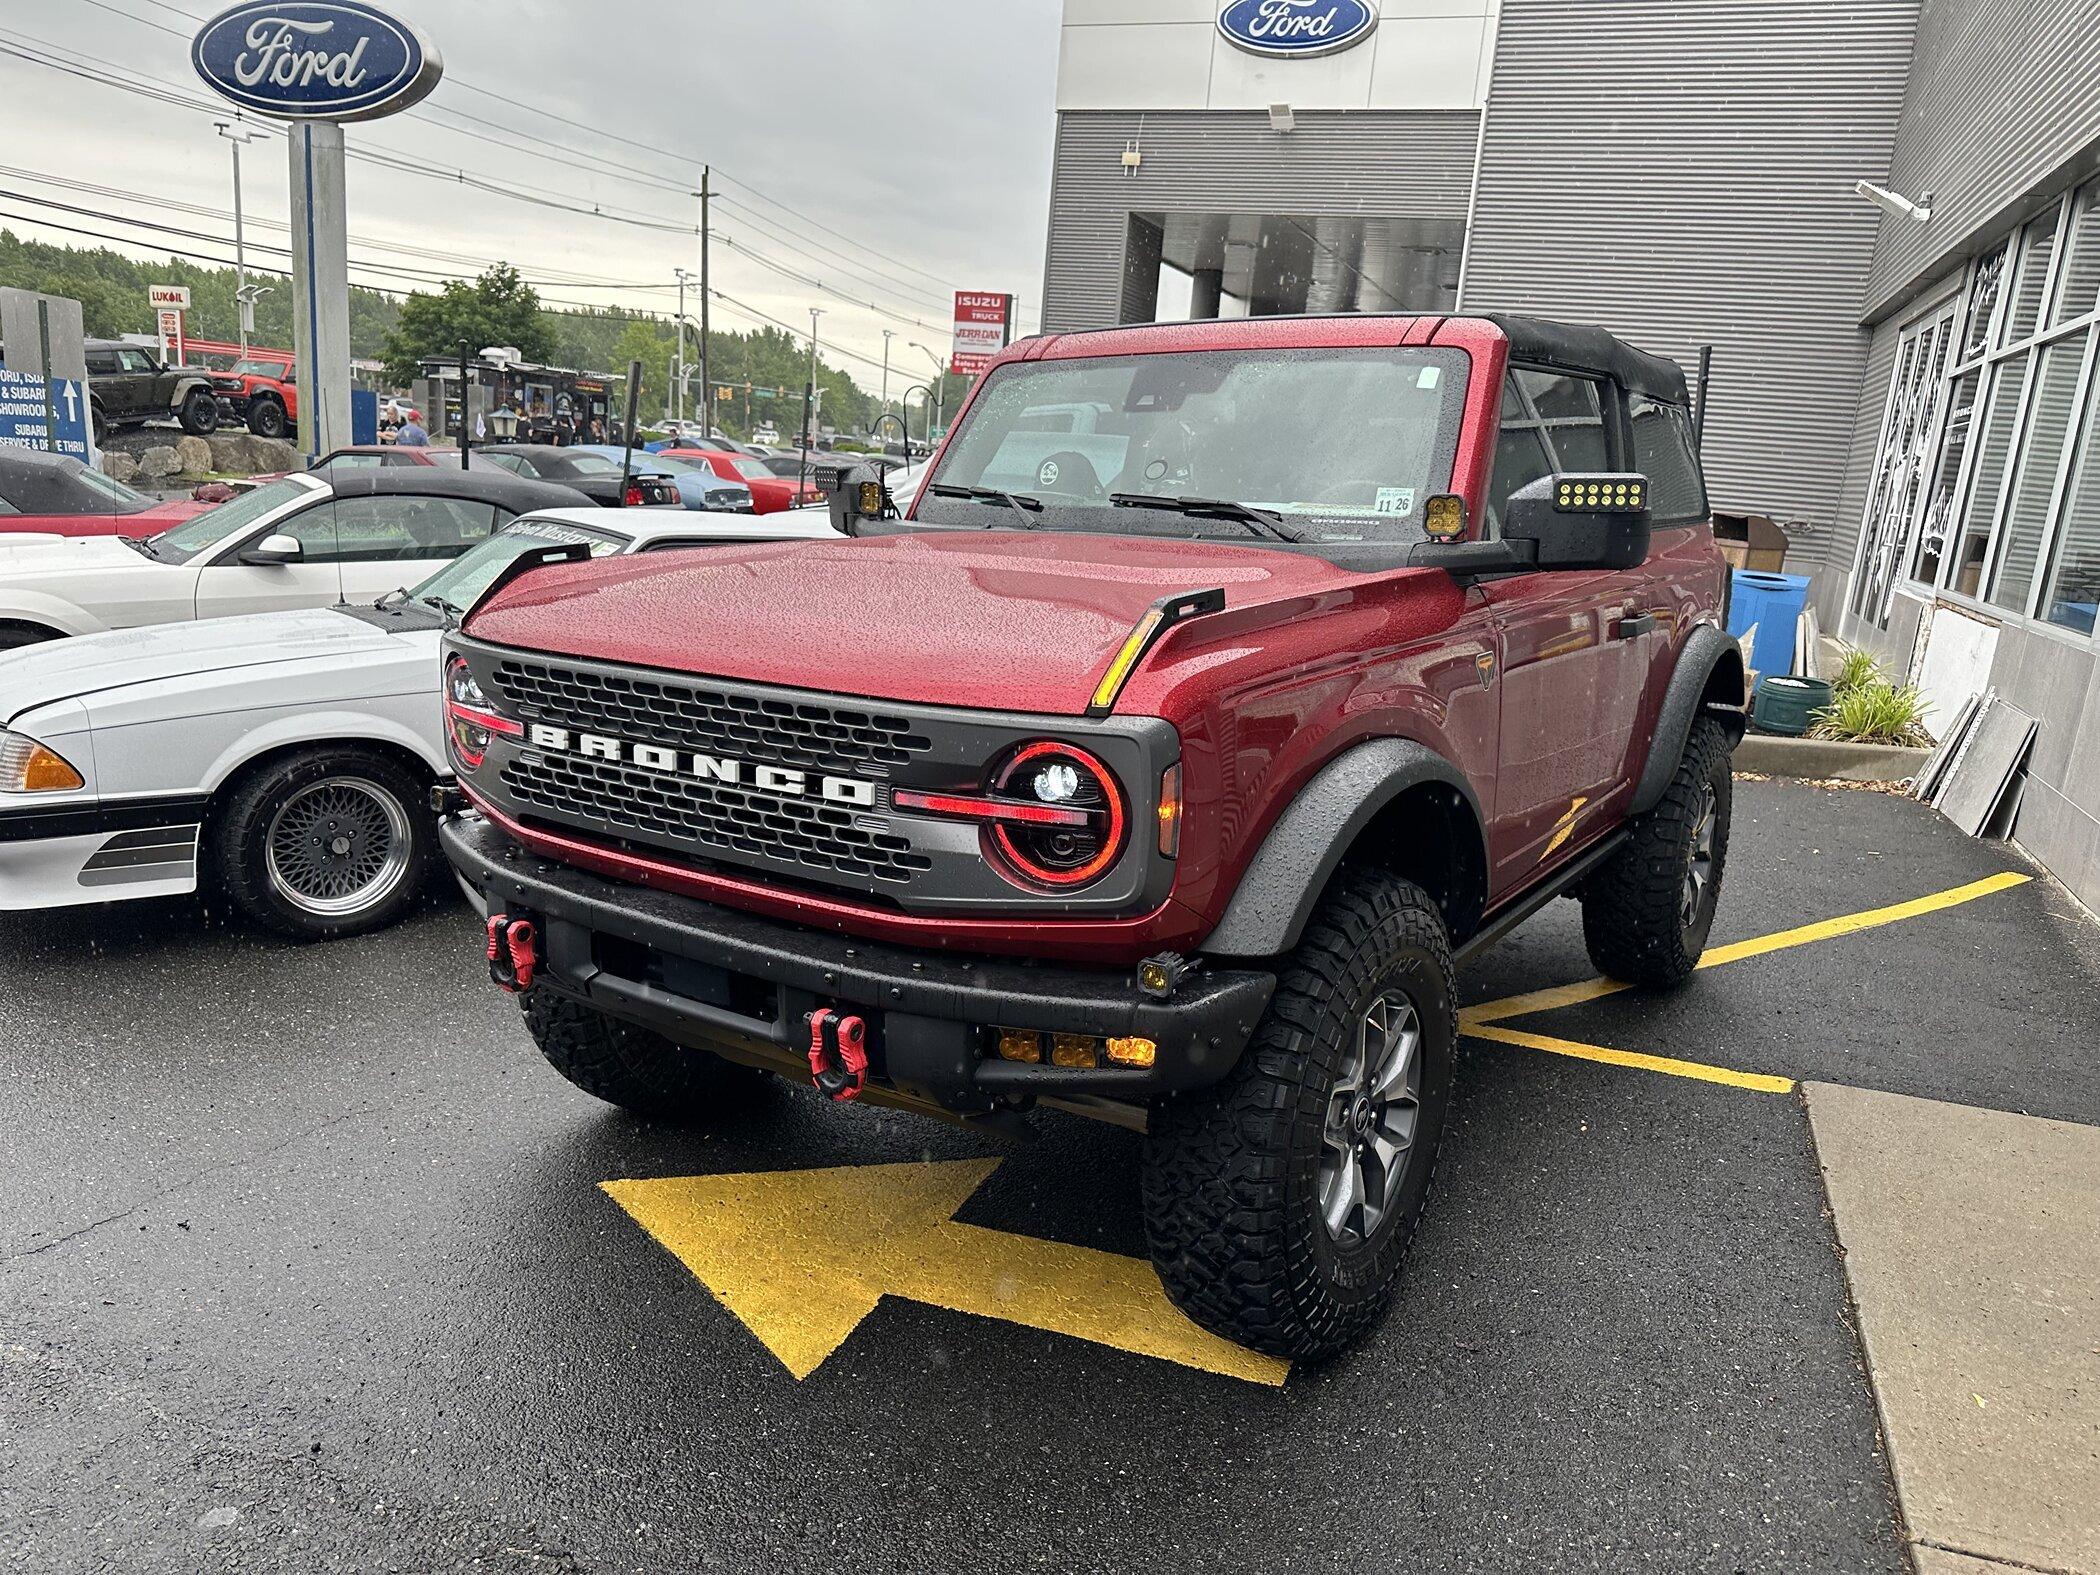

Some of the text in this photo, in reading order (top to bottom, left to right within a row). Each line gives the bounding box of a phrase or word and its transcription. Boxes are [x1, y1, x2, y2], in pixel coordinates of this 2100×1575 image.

[1249, 0, 1339, 37] Ford
[234, 17, 370, 88] Ford
[152, 291, 184, 303] LUKOIL
[957, 296, 1001, 308] ISUZU
[971, 312, 1000, 321] TRUCK
[0, 369, 45, 385] ORD, ISUZ
[1, 386, 9, 399] &
[14, 423, 48, 437] SUBARU
[0, 436, 85, 453] SERVICE & DRE THRU
[1377, 498, 1409, 512] 11 26
[531, 723, 876, 806] BRONCO
